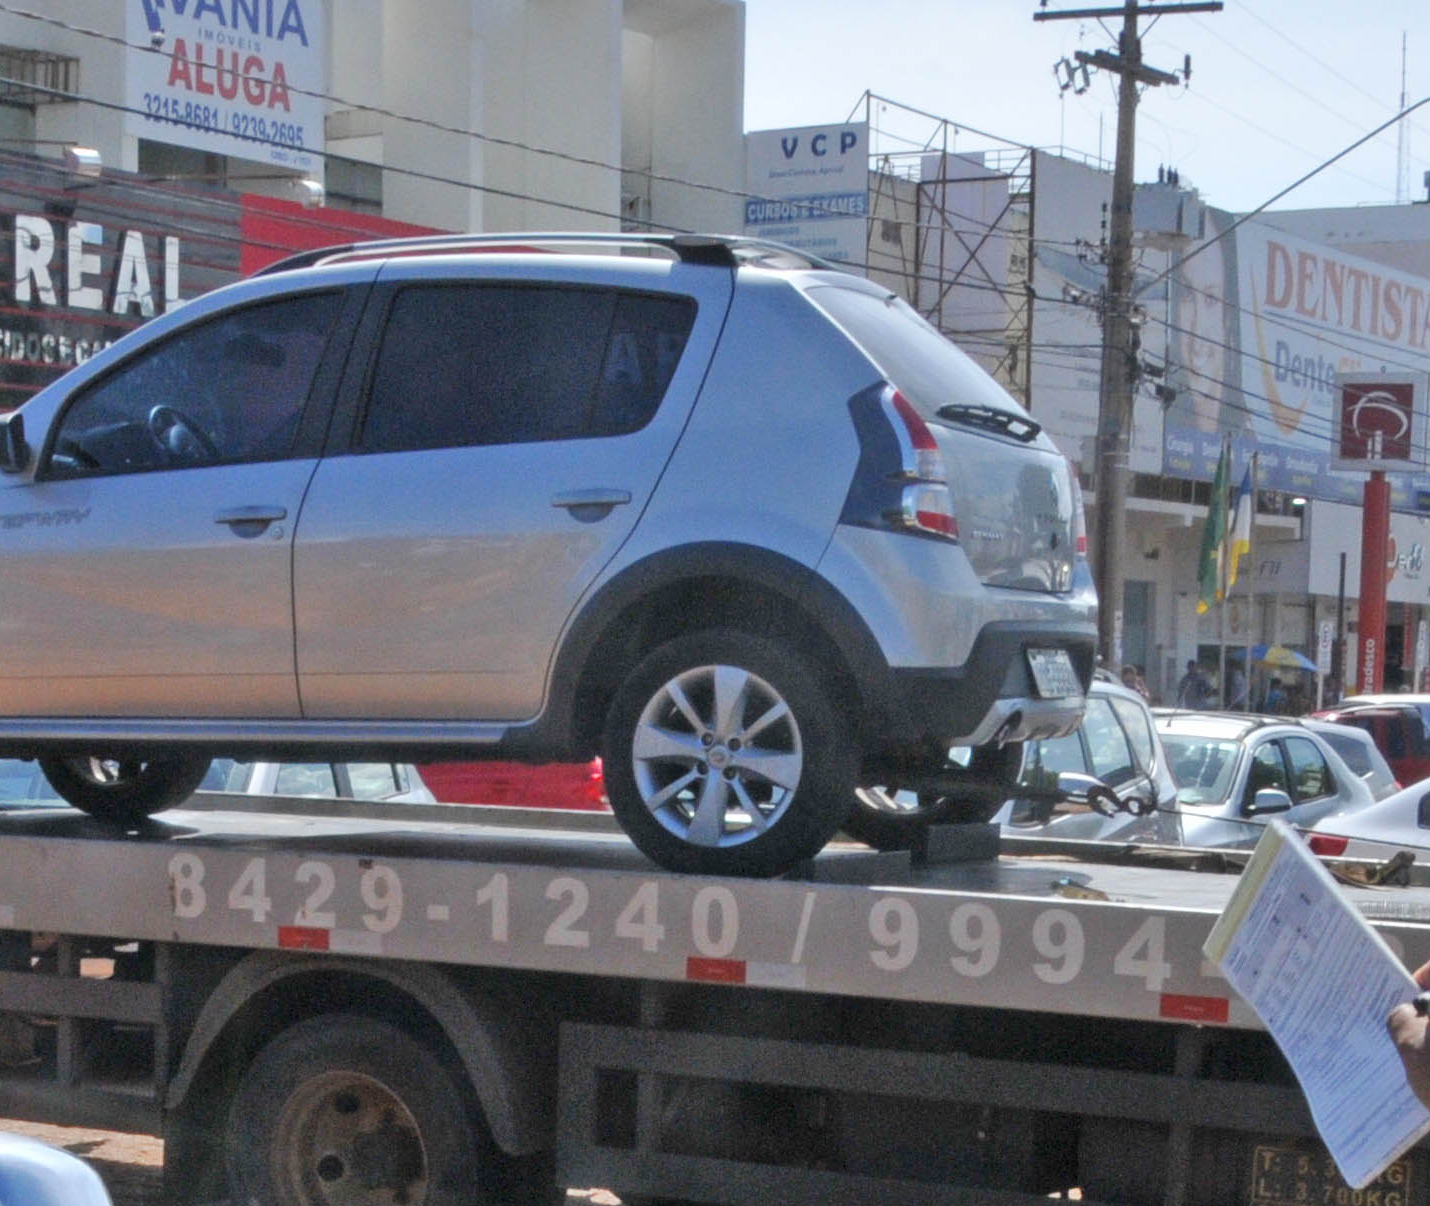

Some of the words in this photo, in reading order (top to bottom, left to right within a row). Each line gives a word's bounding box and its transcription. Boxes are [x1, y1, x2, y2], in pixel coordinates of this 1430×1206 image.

[168, 37, 291, 112] ALUGA
[14, 213, 191, 318] REAL
[169, 852, 740, 958] 8429-1240
